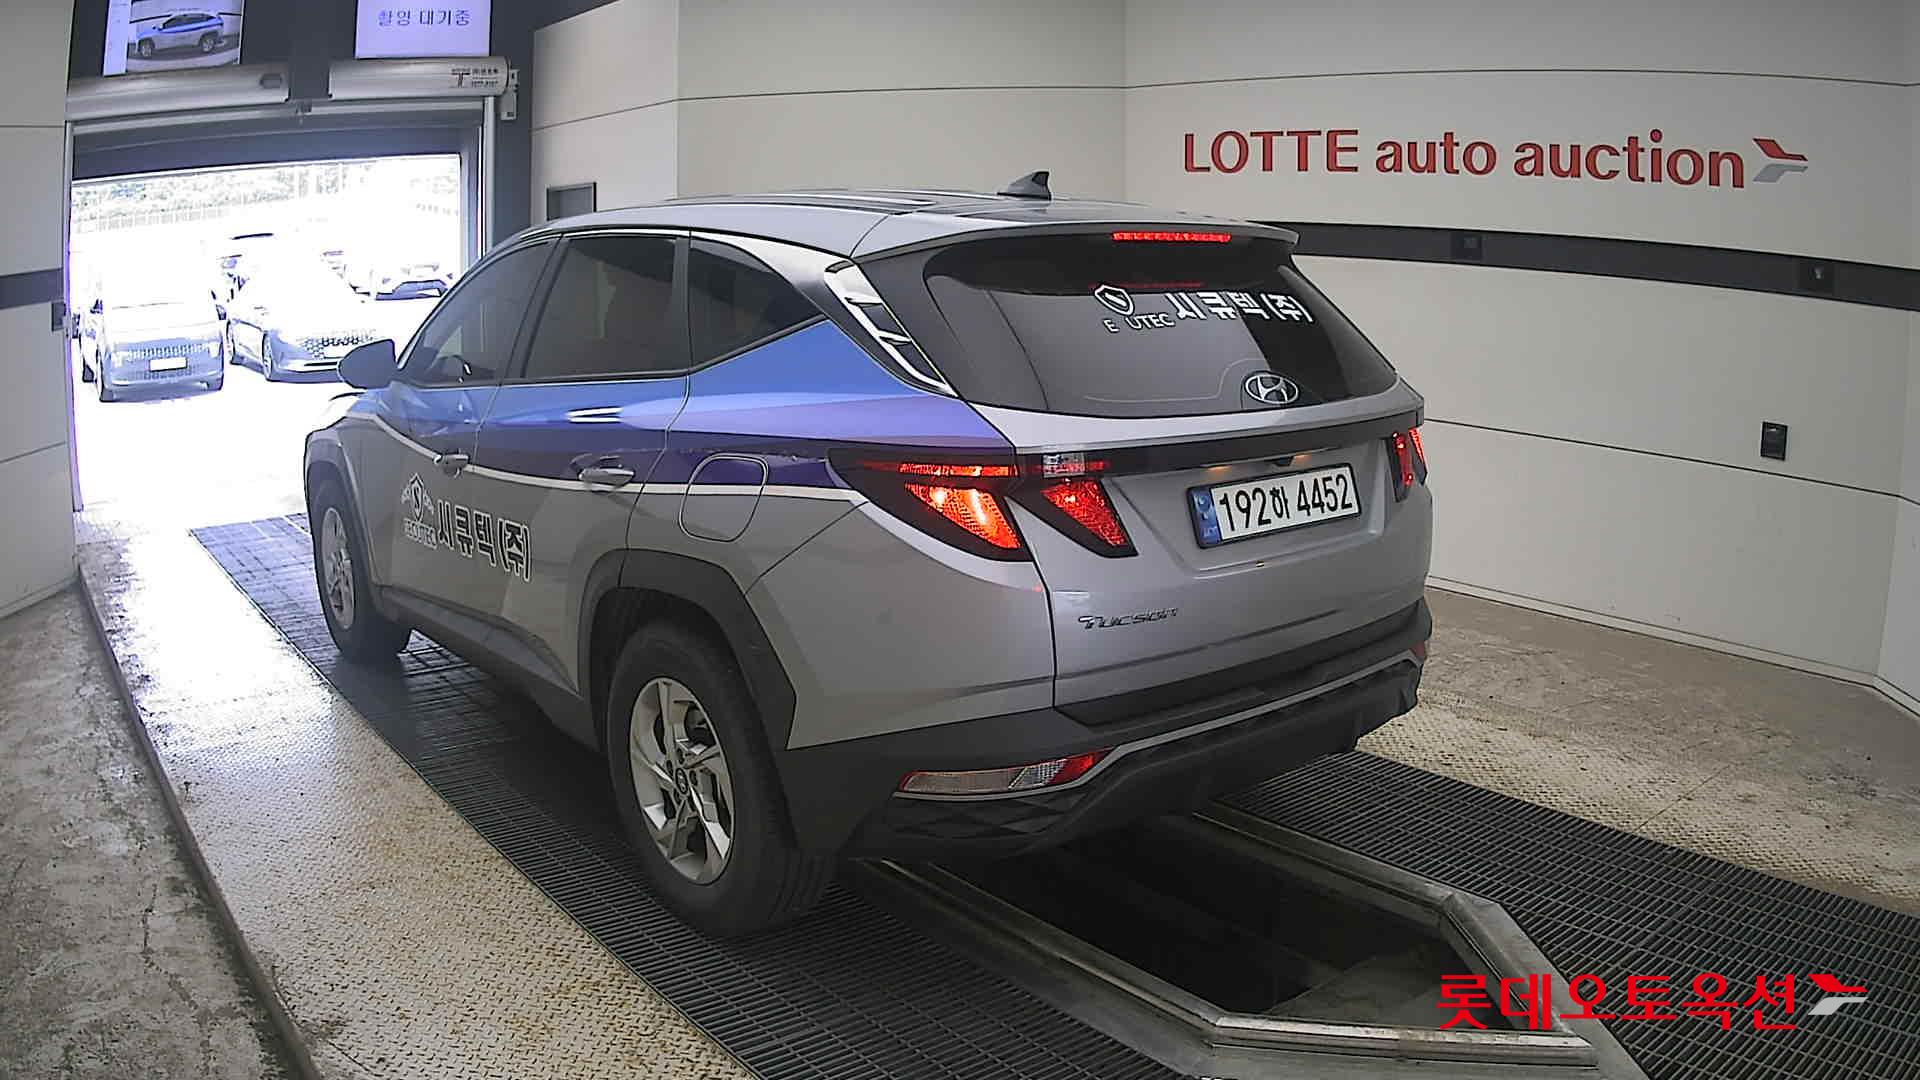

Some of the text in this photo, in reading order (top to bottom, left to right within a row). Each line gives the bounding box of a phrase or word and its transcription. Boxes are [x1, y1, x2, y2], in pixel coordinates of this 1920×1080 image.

[419, 9, 470, 26] 대기중
[1184, 128, 1745, 188] LOTTE auto auction
[1219, 473, 1353, 532] 192하 4452
